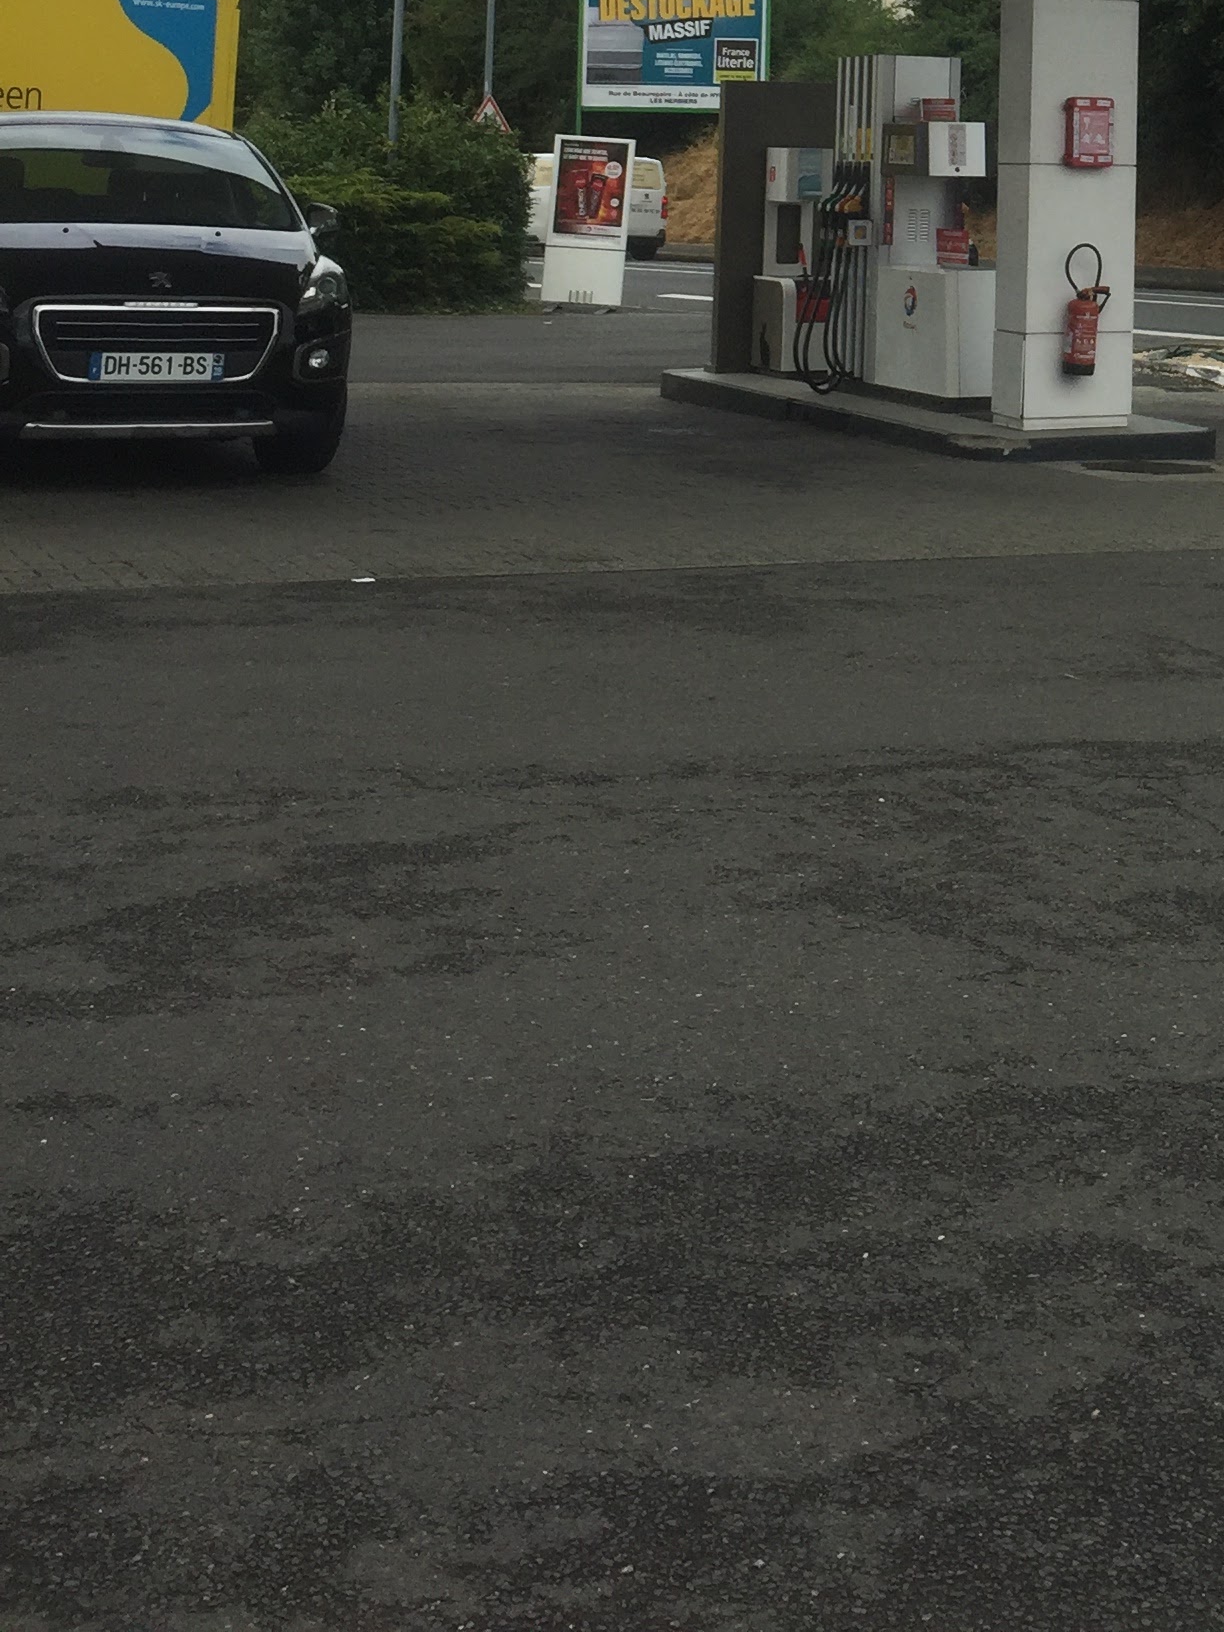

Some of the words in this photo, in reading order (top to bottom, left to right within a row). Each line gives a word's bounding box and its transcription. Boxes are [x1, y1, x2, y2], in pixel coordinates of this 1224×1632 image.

[648, 18, 712, 42] MASSIF
[722, 46, 751, 57] France
[0, 85, 42, 111] en
[103, 355, 208, 376] DH-561-BS
